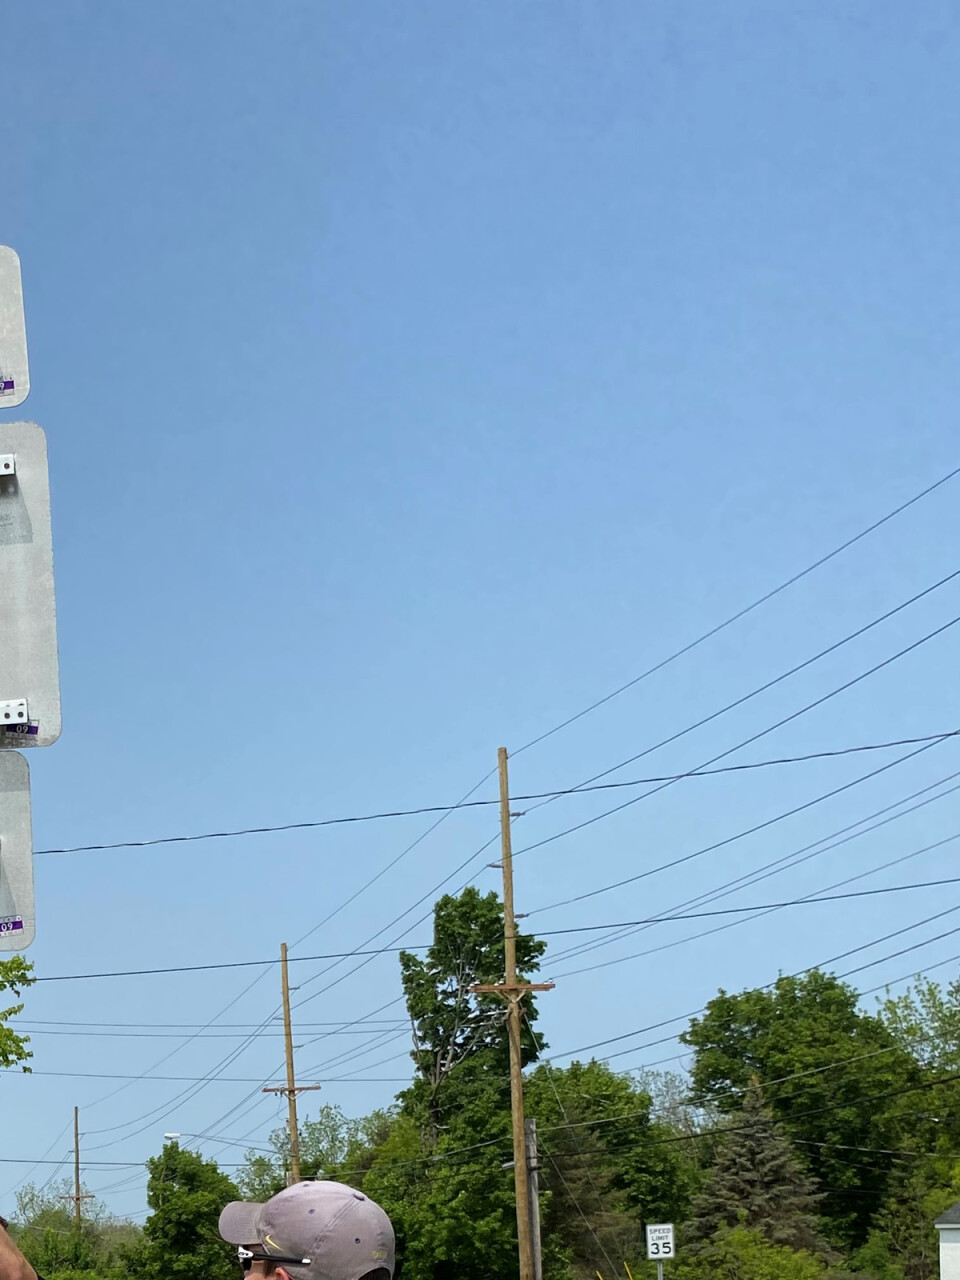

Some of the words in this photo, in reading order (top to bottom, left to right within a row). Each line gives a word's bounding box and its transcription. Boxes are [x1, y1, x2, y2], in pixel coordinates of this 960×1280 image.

[16, 725, 29, 734] 09
[1, 922, 13, 932] 09
[651, 1242, 671, 1254] 35
